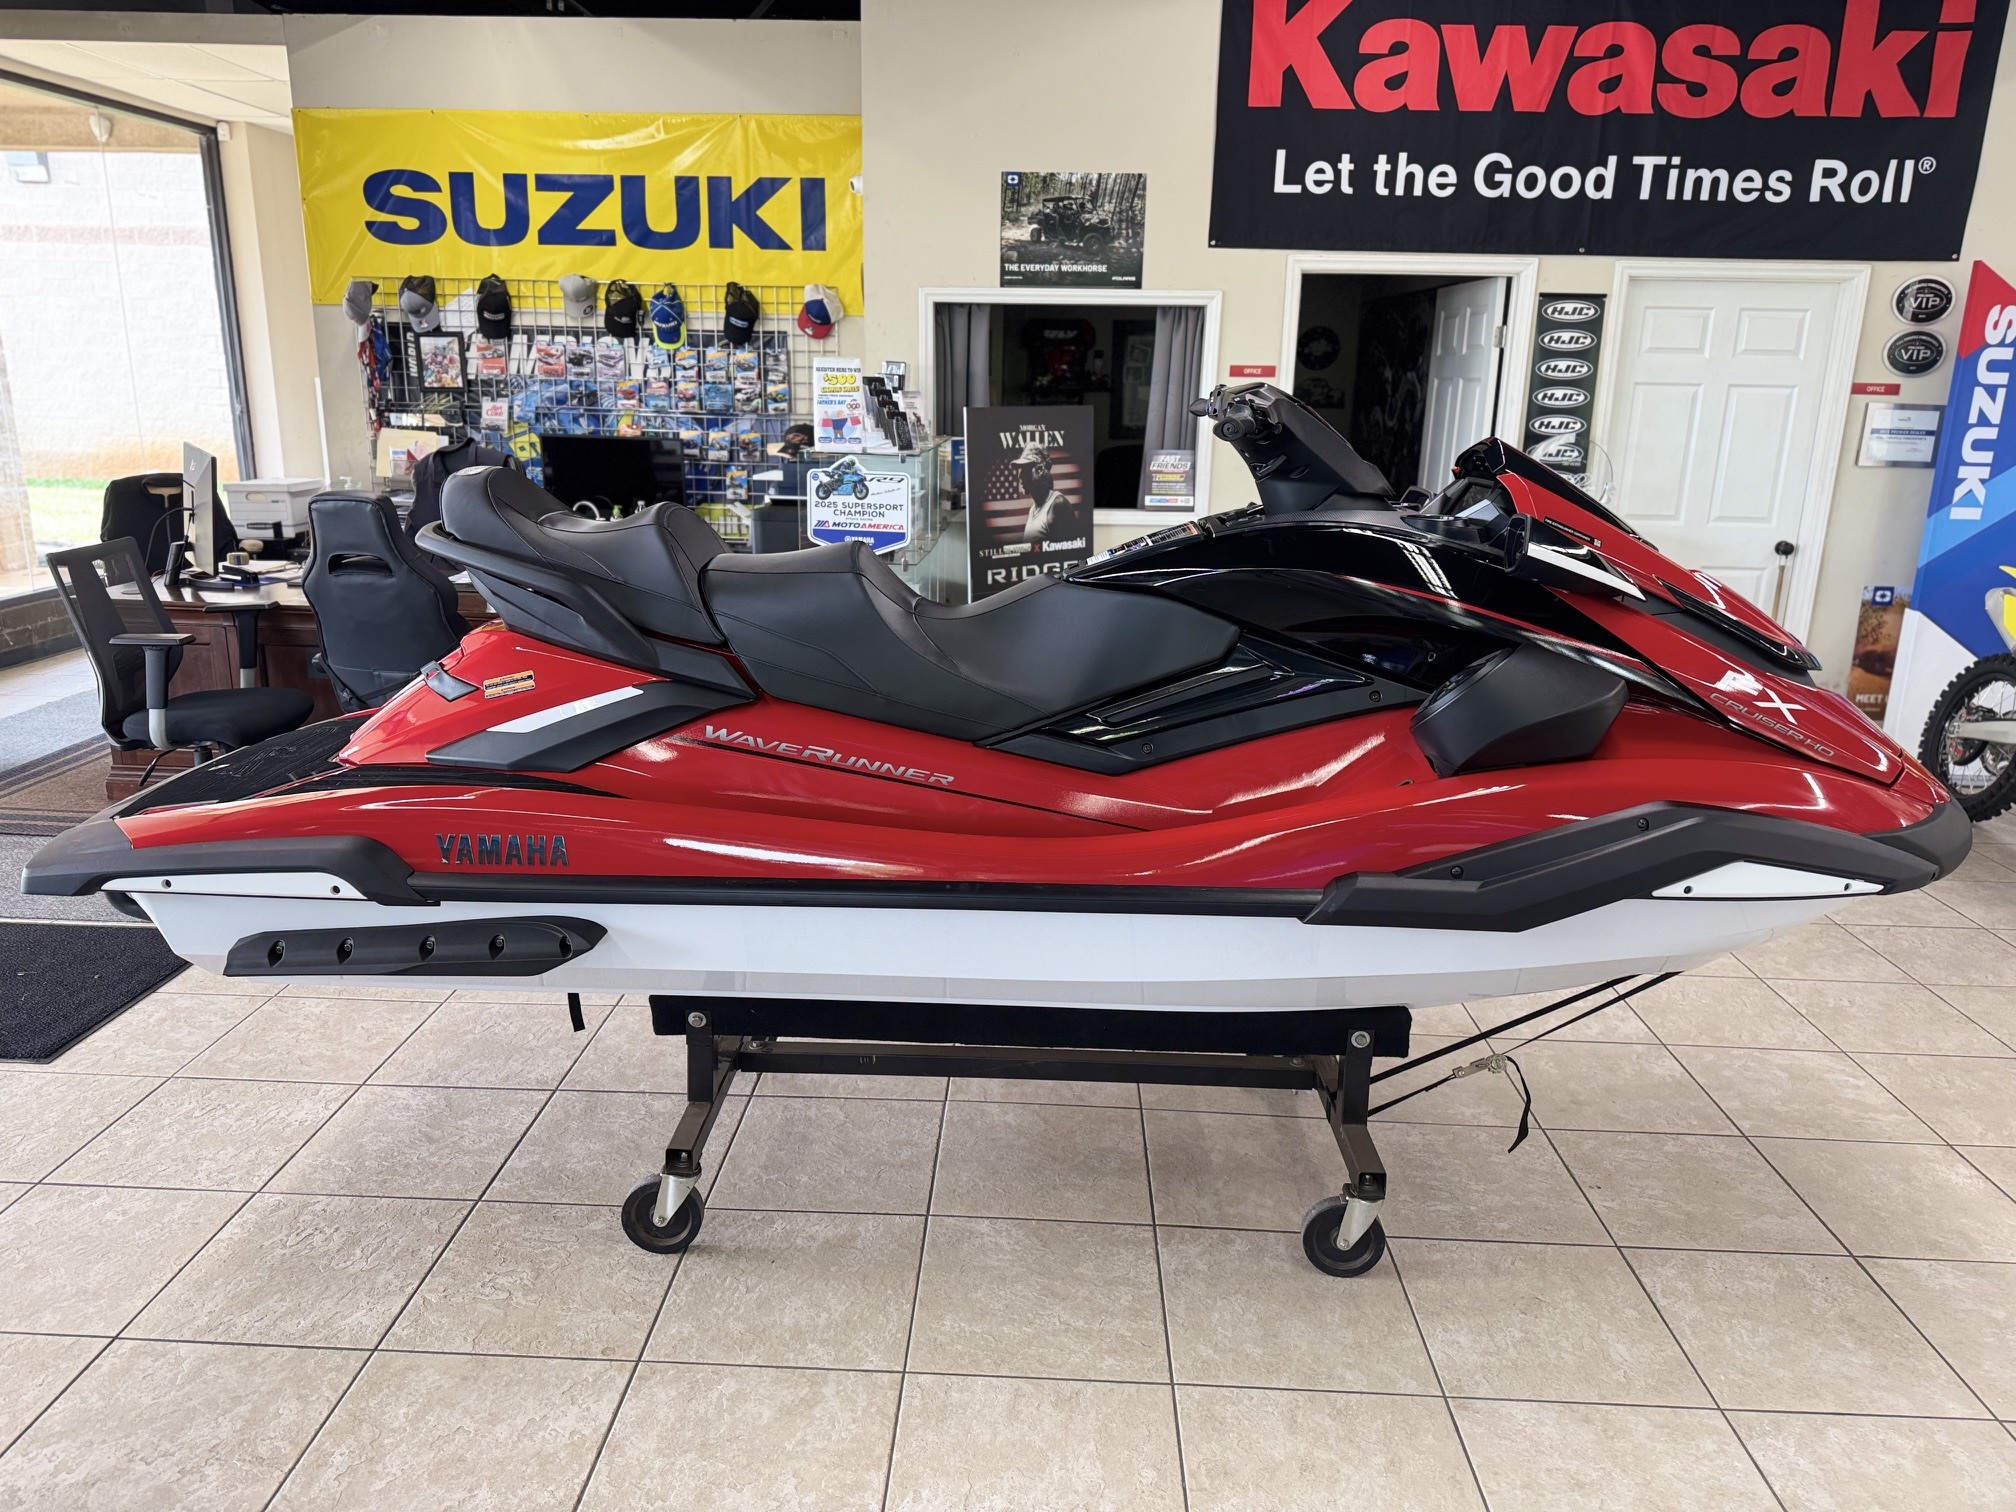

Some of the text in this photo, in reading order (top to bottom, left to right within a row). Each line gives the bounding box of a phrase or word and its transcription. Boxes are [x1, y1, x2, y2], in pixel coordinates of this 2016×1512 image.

[1248, 0, 1973, 118] Kawasaki
[1273, 149, 1355, 194] Let
[1374, 151, 1457, 197] the
[1474, 152, 1615, 200] Good
[1631, 155, 1791, 203] Times
[362, 168, 827, 252] SUZUKI
[1004, 263, 1108, 273] THE EVERYDAY WORKHORSE
[1909, 297, 1941, 309] VIP
[1549, 306, 1592, 316] HJC
[1546, 335, 1589, 345] HJC
[1900, 348, 1931, 361] VIP
[1543, 364, 1586, 374] HJC
[823, 373, 857, 385] $500
[1866, 385, 1886, 393] OFFICE
[1540, 392, 1582, 402] HJC
[1949, 303, 2016, 521] SUZUKI
[1537, 420, 1578, 431] HJC
[999, 430, 1065, 450] WALLEN
[1151, 462, 1189, 470] FRIENDS
[814, 500, 904, 511] 2025 SUPERSPORT
[833, 508, 885, 518] CHAMPION
[831, 521, 905, 530] MOTOAMERICA
[979, 547, 1003, 558] STILL
[1041, 536, 1086, 552] Kawasaki
[1855, 693, 1883, 703] MEET
[1709, 692, 1835, 757] CRUISER HO
[434, 833, 571, 867] YAMAHA
